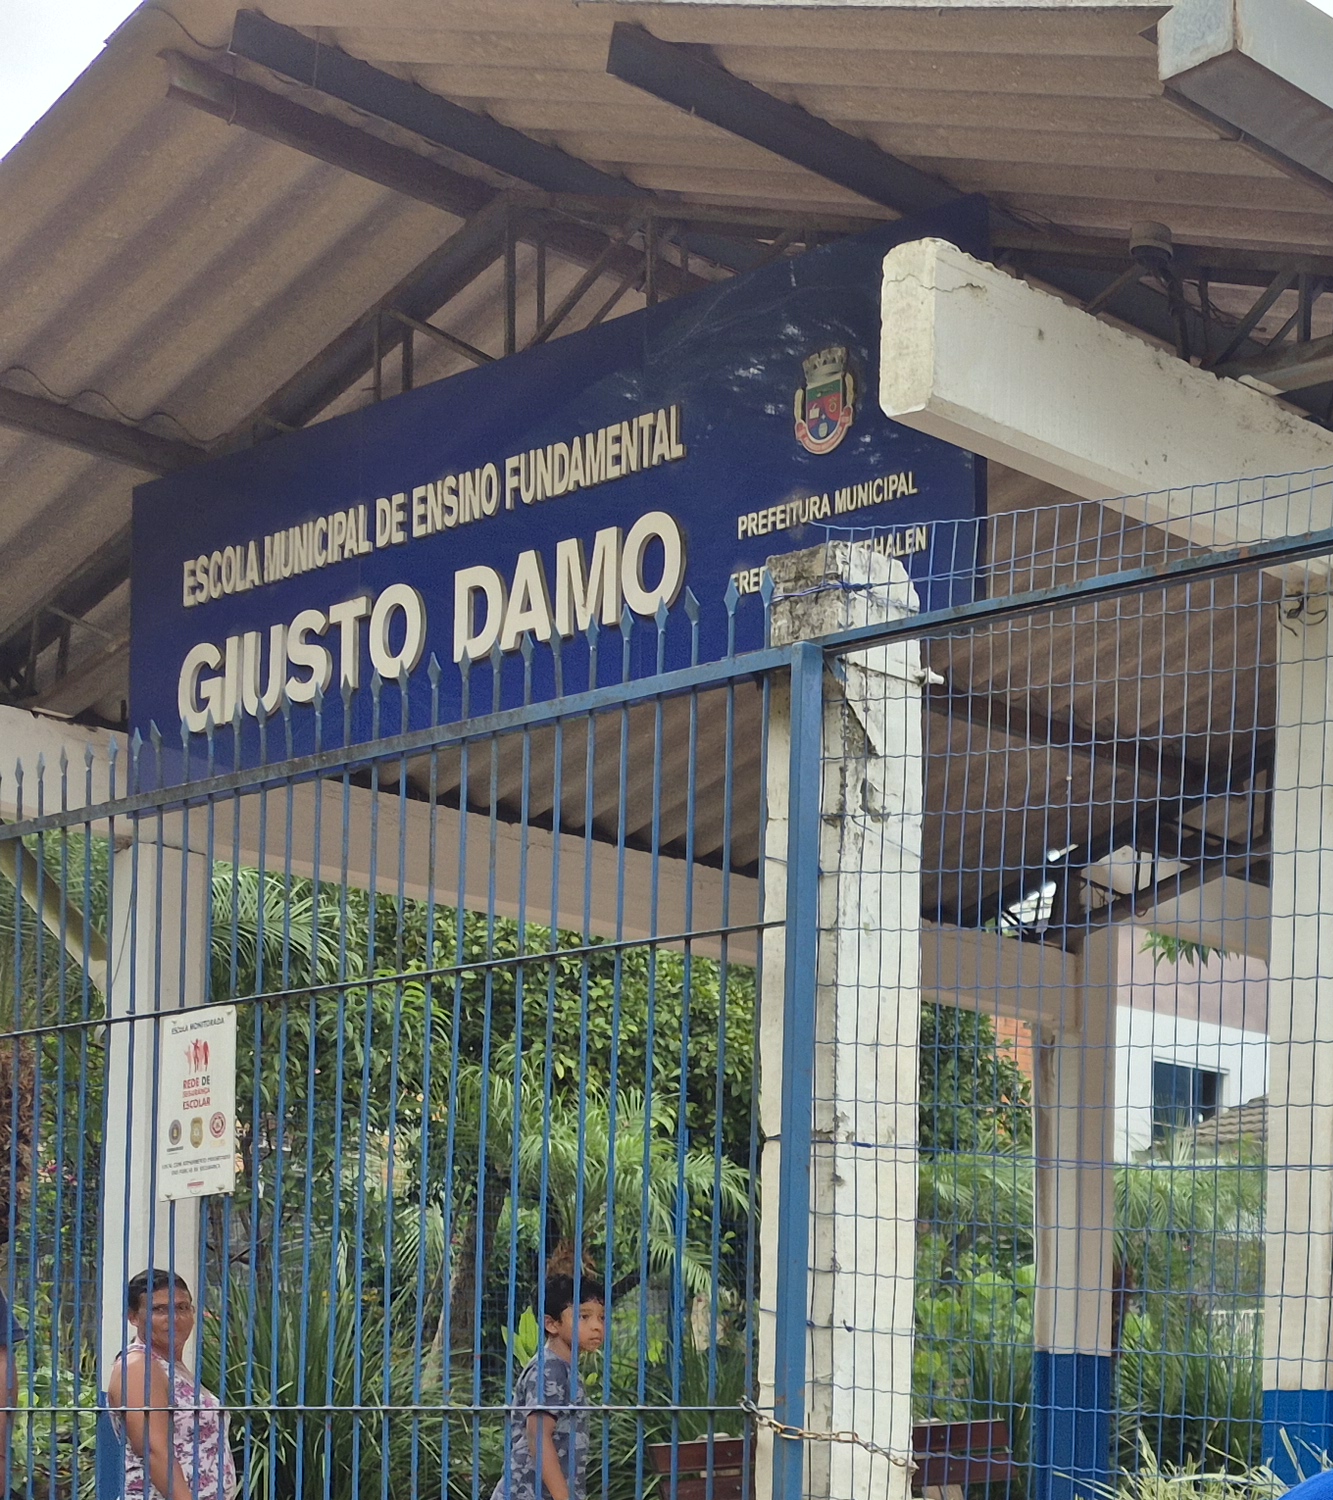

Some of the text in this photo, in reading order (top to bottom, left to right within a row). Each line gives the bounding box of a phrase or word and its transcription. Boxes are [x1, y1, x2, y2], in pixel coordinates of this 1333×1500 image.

[183, 404, 687, 607] ESCOLA MUNICIPAL DE ENSINO FUNDAMENTAL
[737, 470, 918, 540] PREFEITURA MUNICIPAL
[178, 510, 687, 733] GIUSTO DAMO
[183, 1075, 211, 1089] REDE DE
[183, 1097, 211, 1111] ESCOLAR
